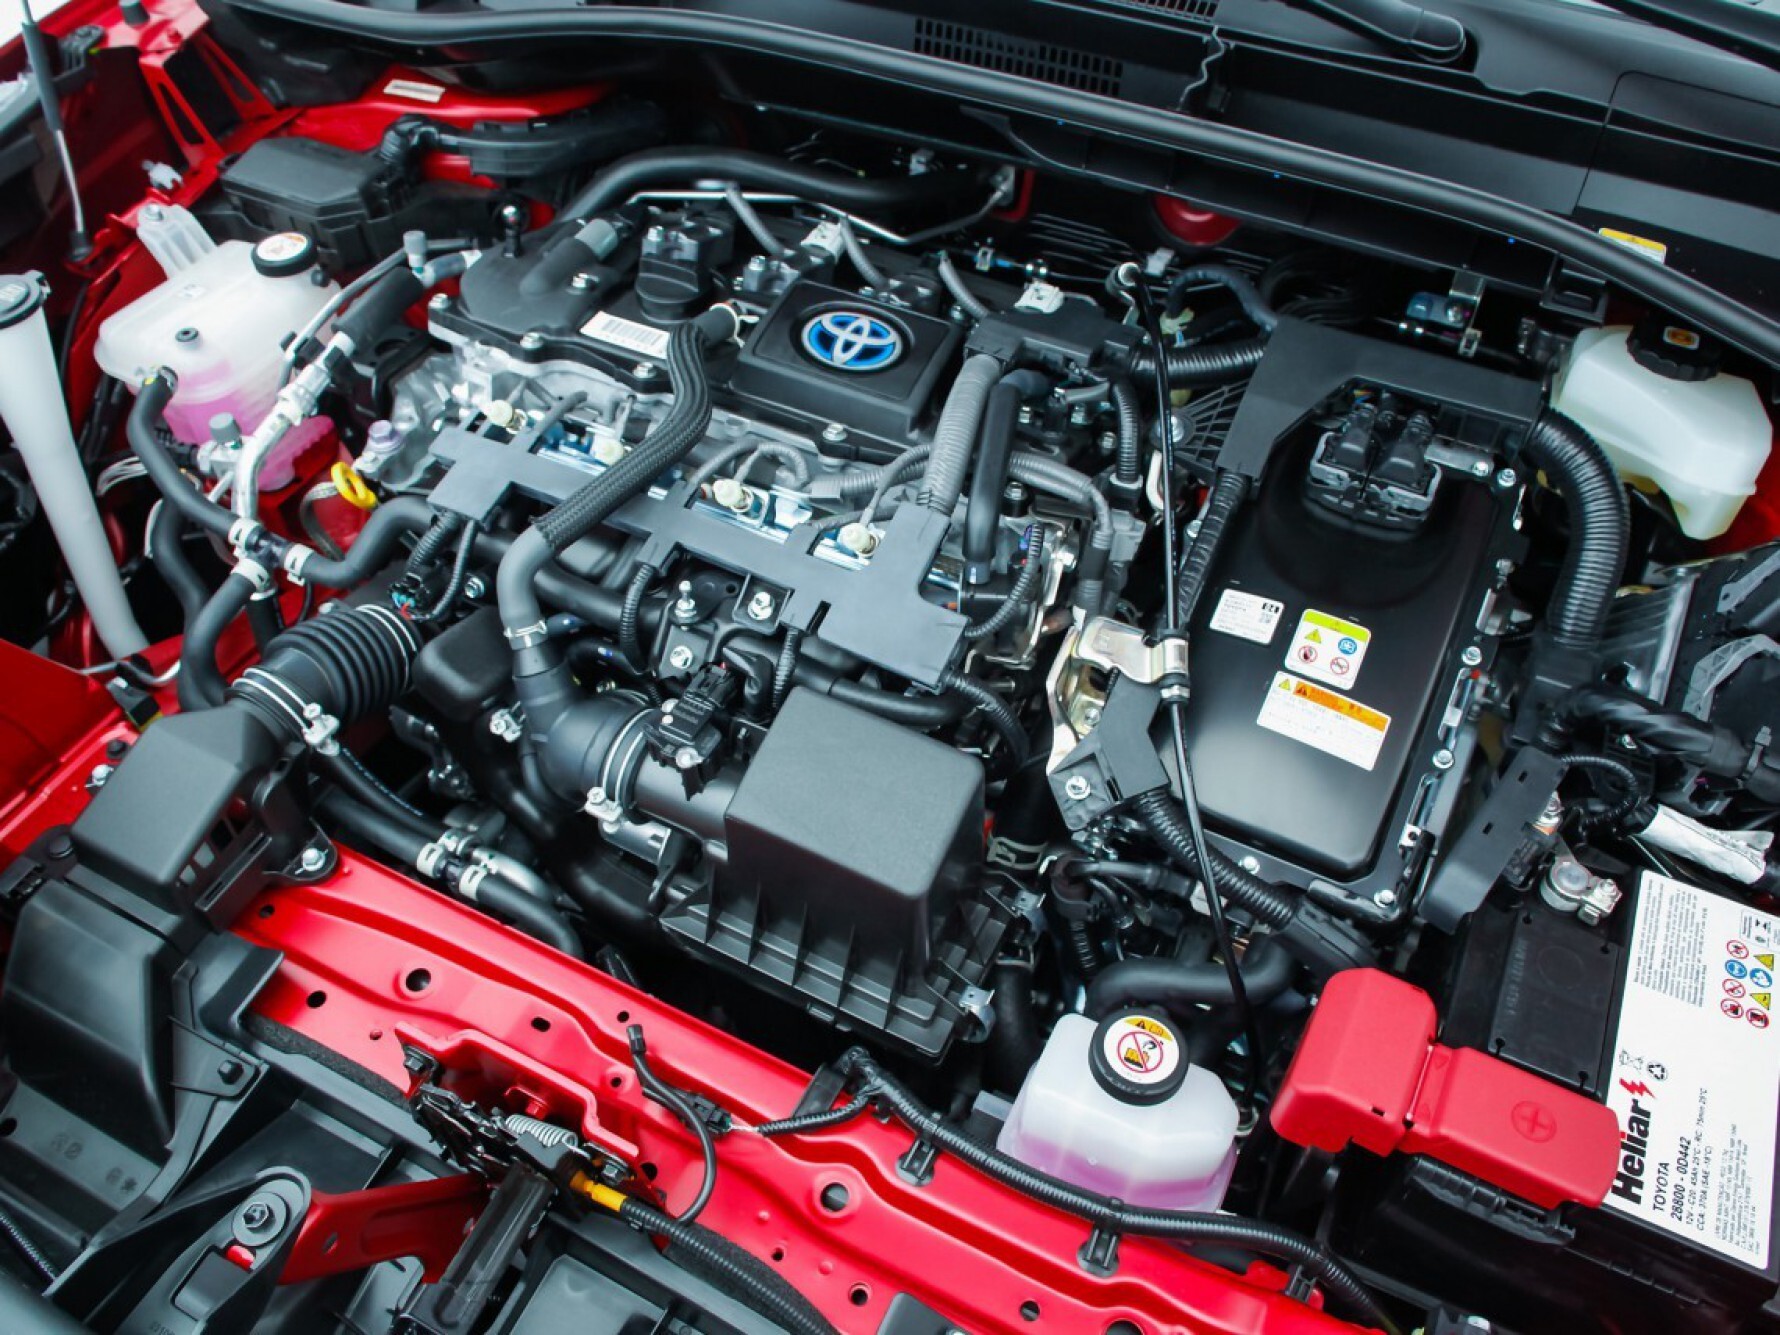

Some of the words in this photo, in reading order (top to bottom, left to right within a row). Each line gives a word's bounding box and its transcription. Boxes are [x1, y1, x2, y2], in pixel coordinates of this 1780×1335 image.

[1611, 1099, 1651, 1205] Heliar
[1653, 1162, 1670, 1212] TOYOTA
[1670, 1184, 1686, 1221] 28800
